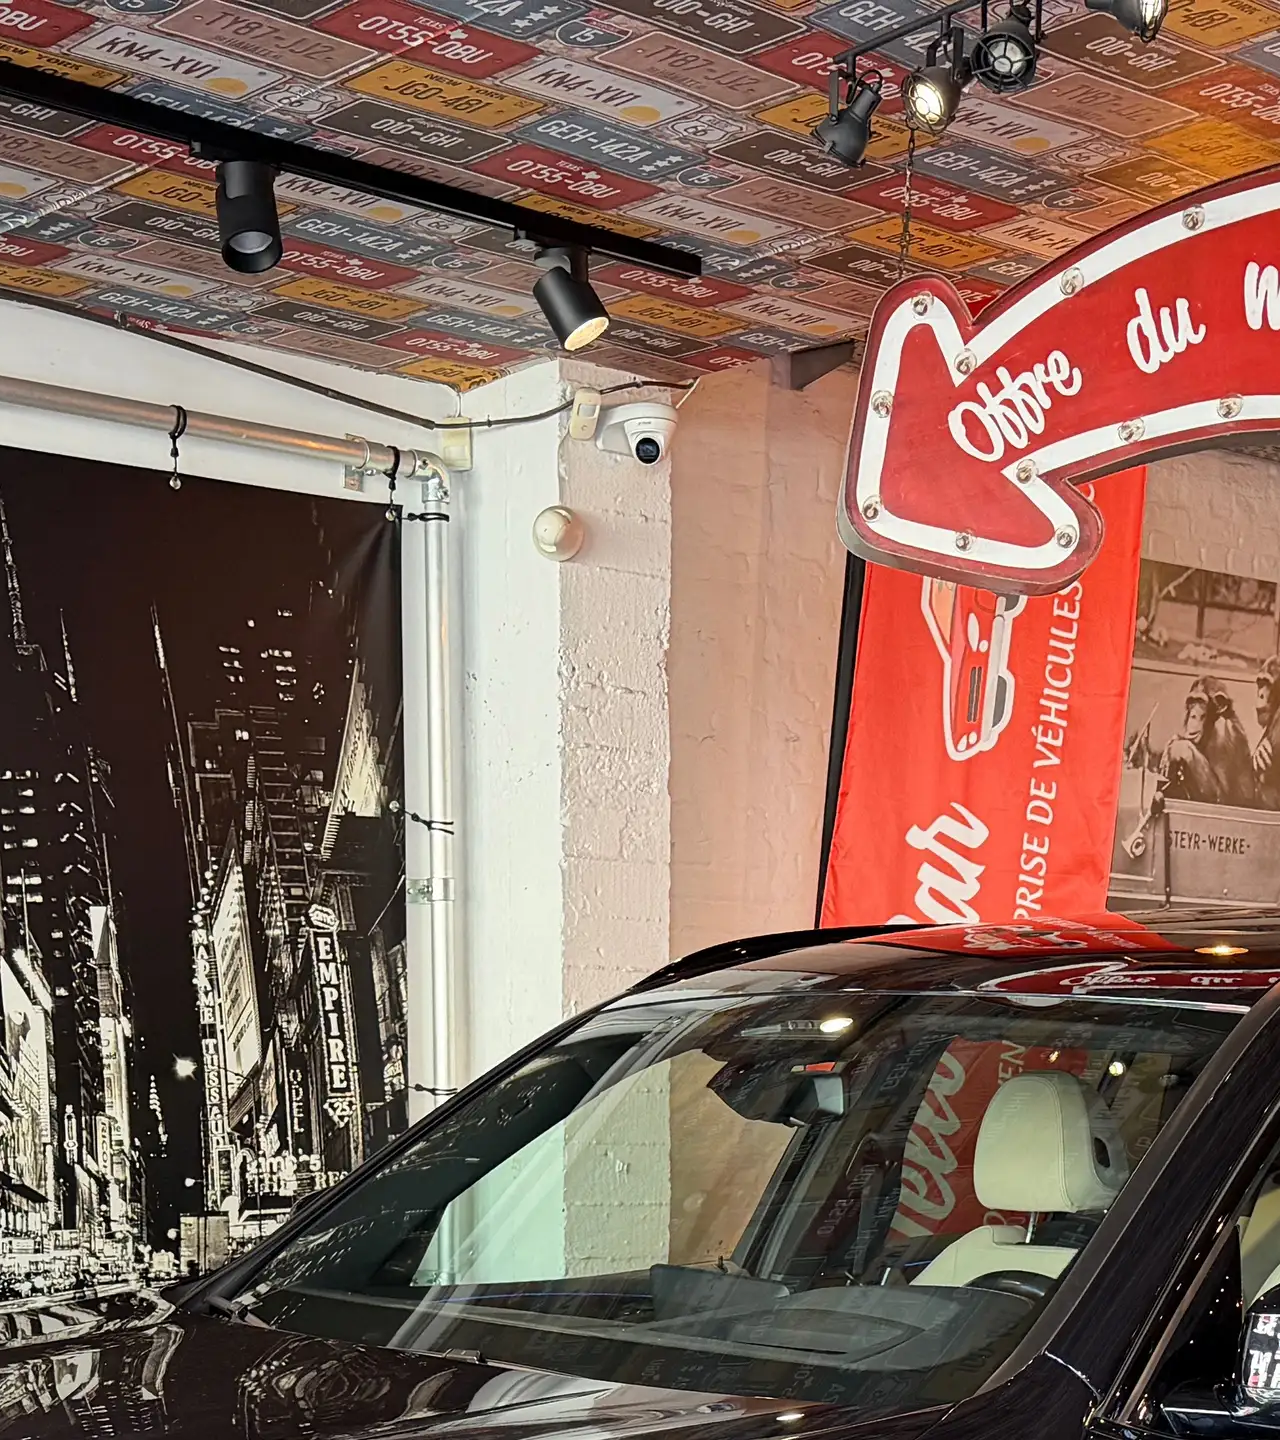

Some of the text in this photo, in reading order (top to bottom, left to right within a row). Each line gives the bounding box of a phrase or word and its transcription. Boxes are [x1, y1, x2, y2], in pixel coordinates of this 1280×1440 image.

[569, 27, 597, 43] 15
[96, 36, 220, 80] KN4-XV1
[384, 80, 491, 115] JGO-481
[424, 72, 507, 101] NEW YORK
[530, 67, 642, 108] KN4-XV1
[536, 118, 652, 165] GEH-142A
[688, 170, 712, 185] 15
[295, 217, 400, 254] GEH-142A
[1125, 286, 1207, 374] du
[1033, 580, 1084, 770] VÉHICULES
[1026, 778, 1058, 827] DE
[316, 936, 349, 1091] EMPIRE
